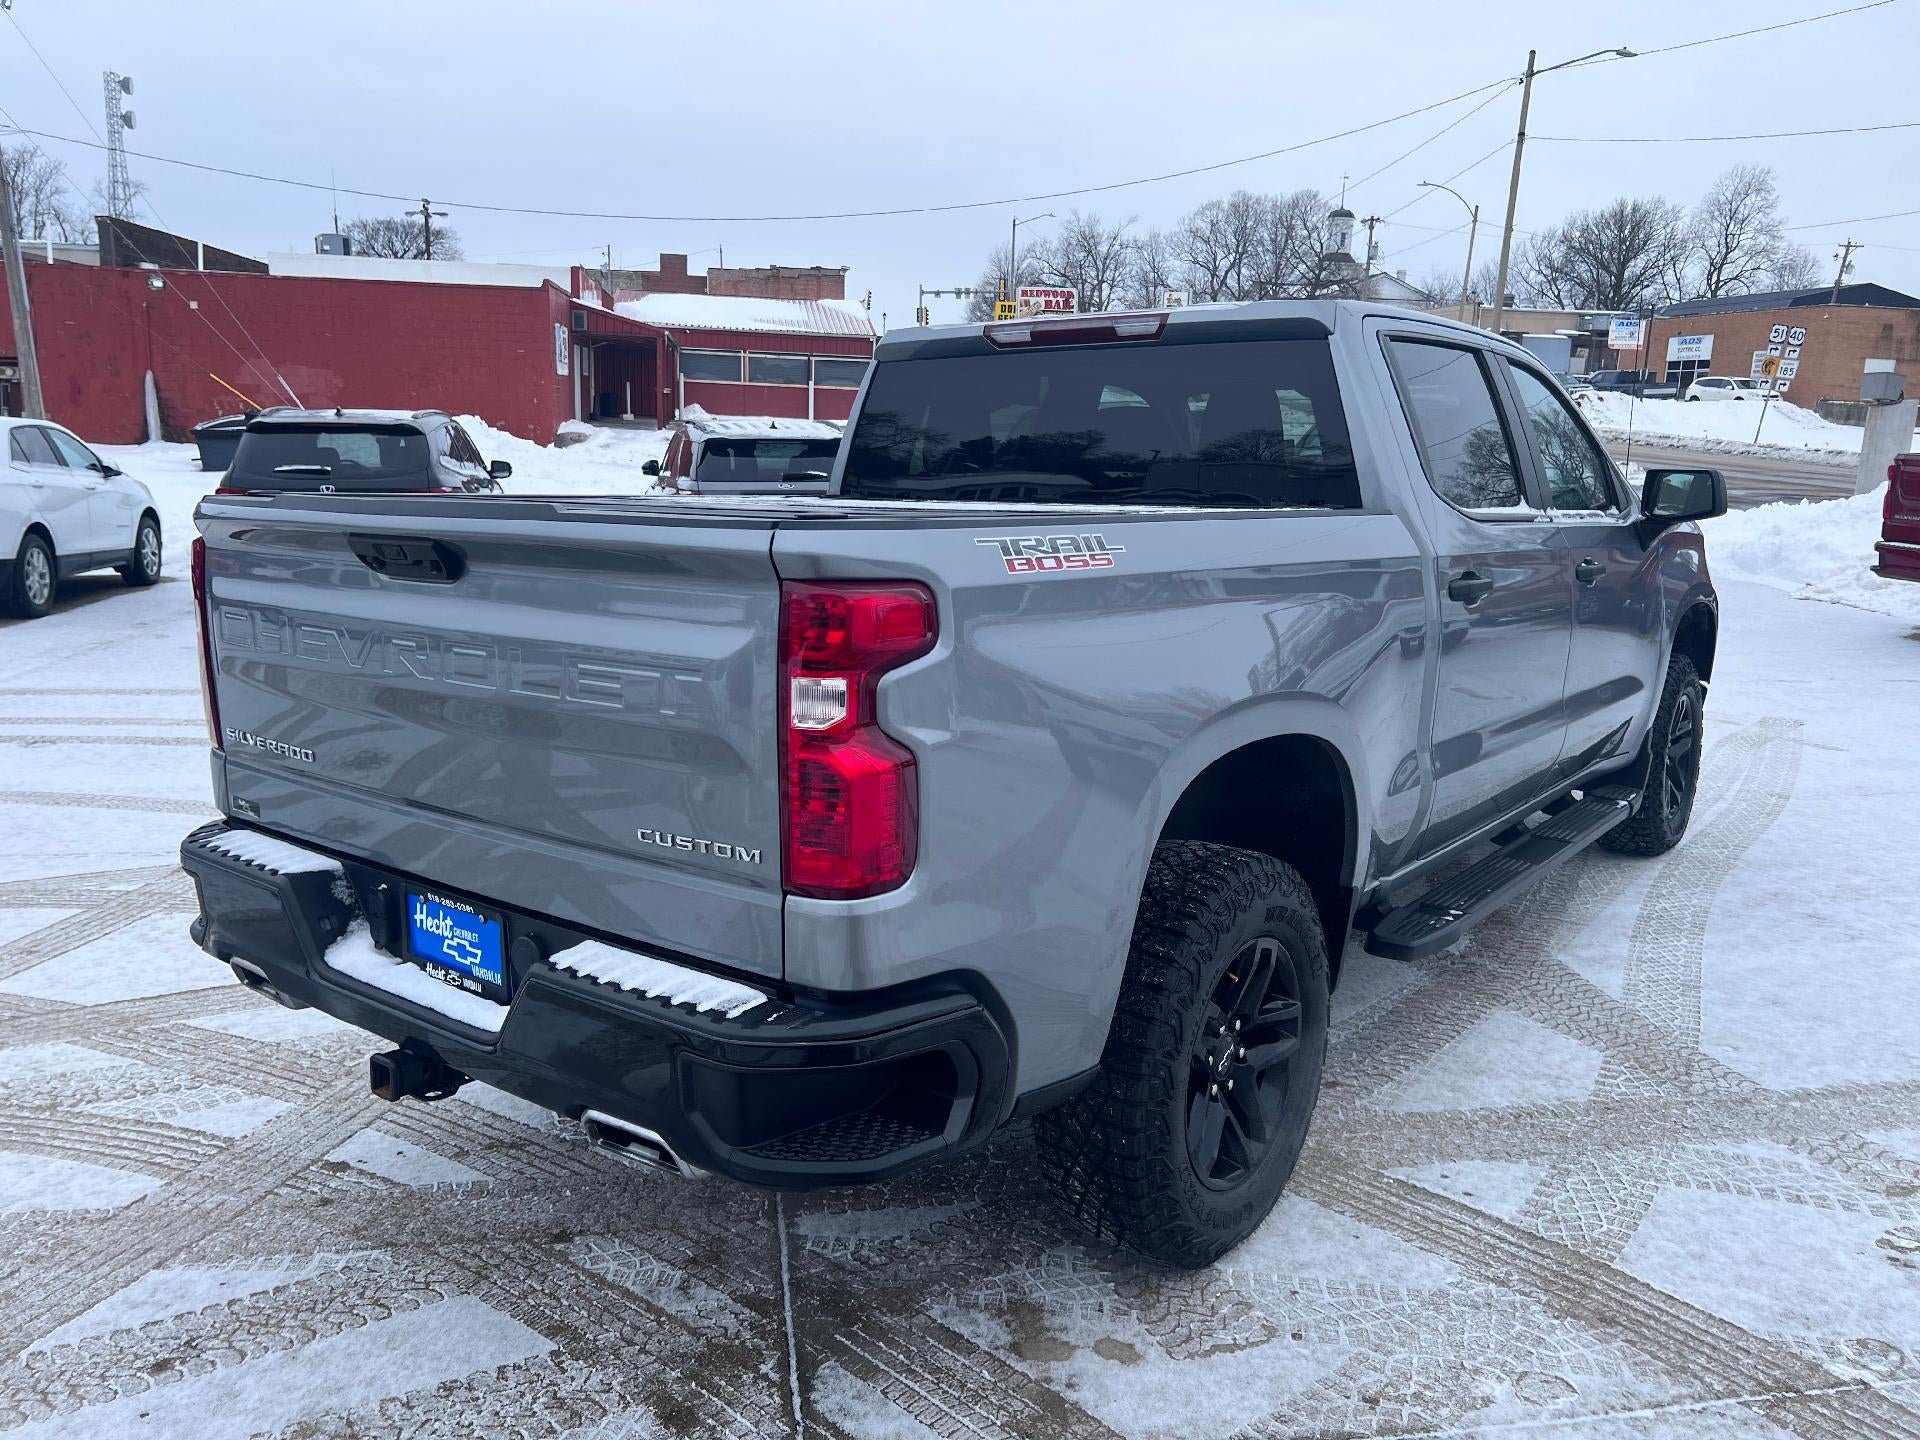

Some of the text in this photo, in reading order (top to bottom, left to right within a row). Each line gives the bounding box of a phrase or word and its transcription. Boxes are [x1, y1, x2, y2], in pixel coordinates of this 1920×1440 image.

[1020, 289, 1075, 299] REDWOOD
[1043, 299, 1073, 310] BAR
[1680, 337, 1703, 345] ADS
[1773, 328, 1785, 340] 51
[1790, 330, 1804, 342] 40
[1780, 367, 1795, 376] 185
[974, 533, 1127, 558] TRAIL
[1004, 552, 1115, 574] BOSS
[219, 605, 705, 715] CHEVROLET
[226, 727, 316, 763] SILVERADO
[636, 827, 763, 865] CUSTOM
[414, 902, 454, 939] Hecht
[426, 962, 446, 981] Hecht
